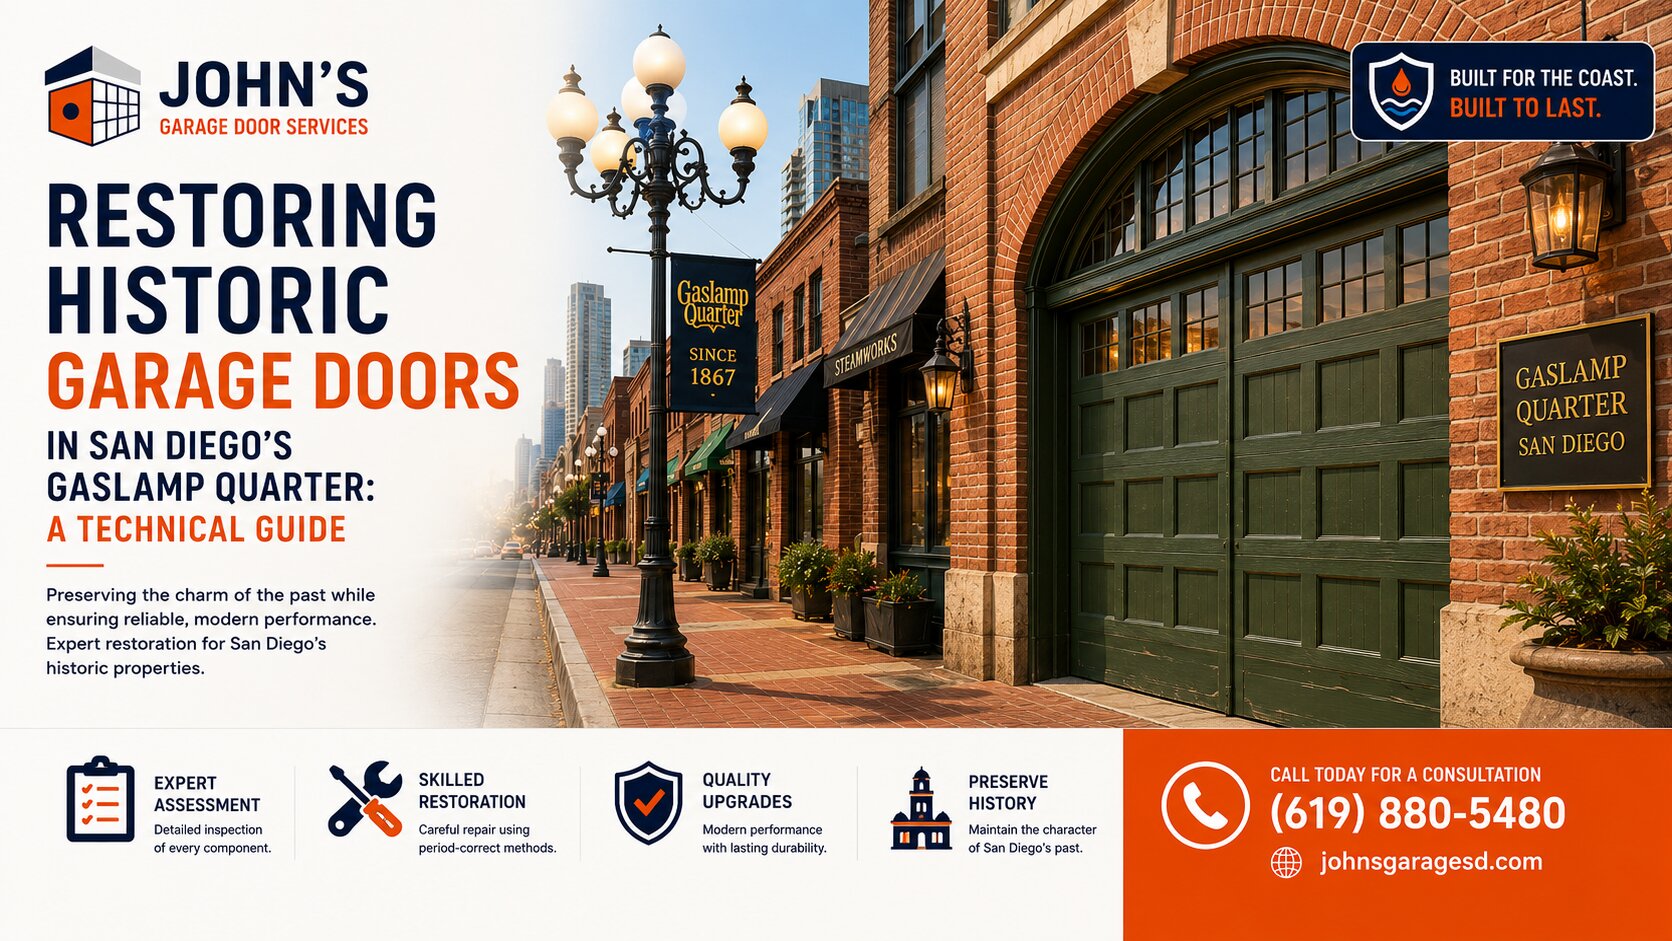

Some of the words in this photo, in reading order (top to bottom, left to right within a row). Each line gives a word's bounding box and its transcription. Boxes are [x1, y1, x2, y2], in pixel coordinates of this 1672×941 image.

[677, 279, 749, 315] Gaslamp
[683, 302, 743, 329] Quarter
[689, 347, 737, 362] SINCE
[834, 332, 897, 376] STEAMWORKS
[691, 367, 736, 386] 1867
[1515, 354, 1627, 390] GASLAMP
[1516, 391, 1628, 426] QUARTER
[1518, 435, 1556, 457] SAN
[1562, 431, 1626, 454] DIEGO
